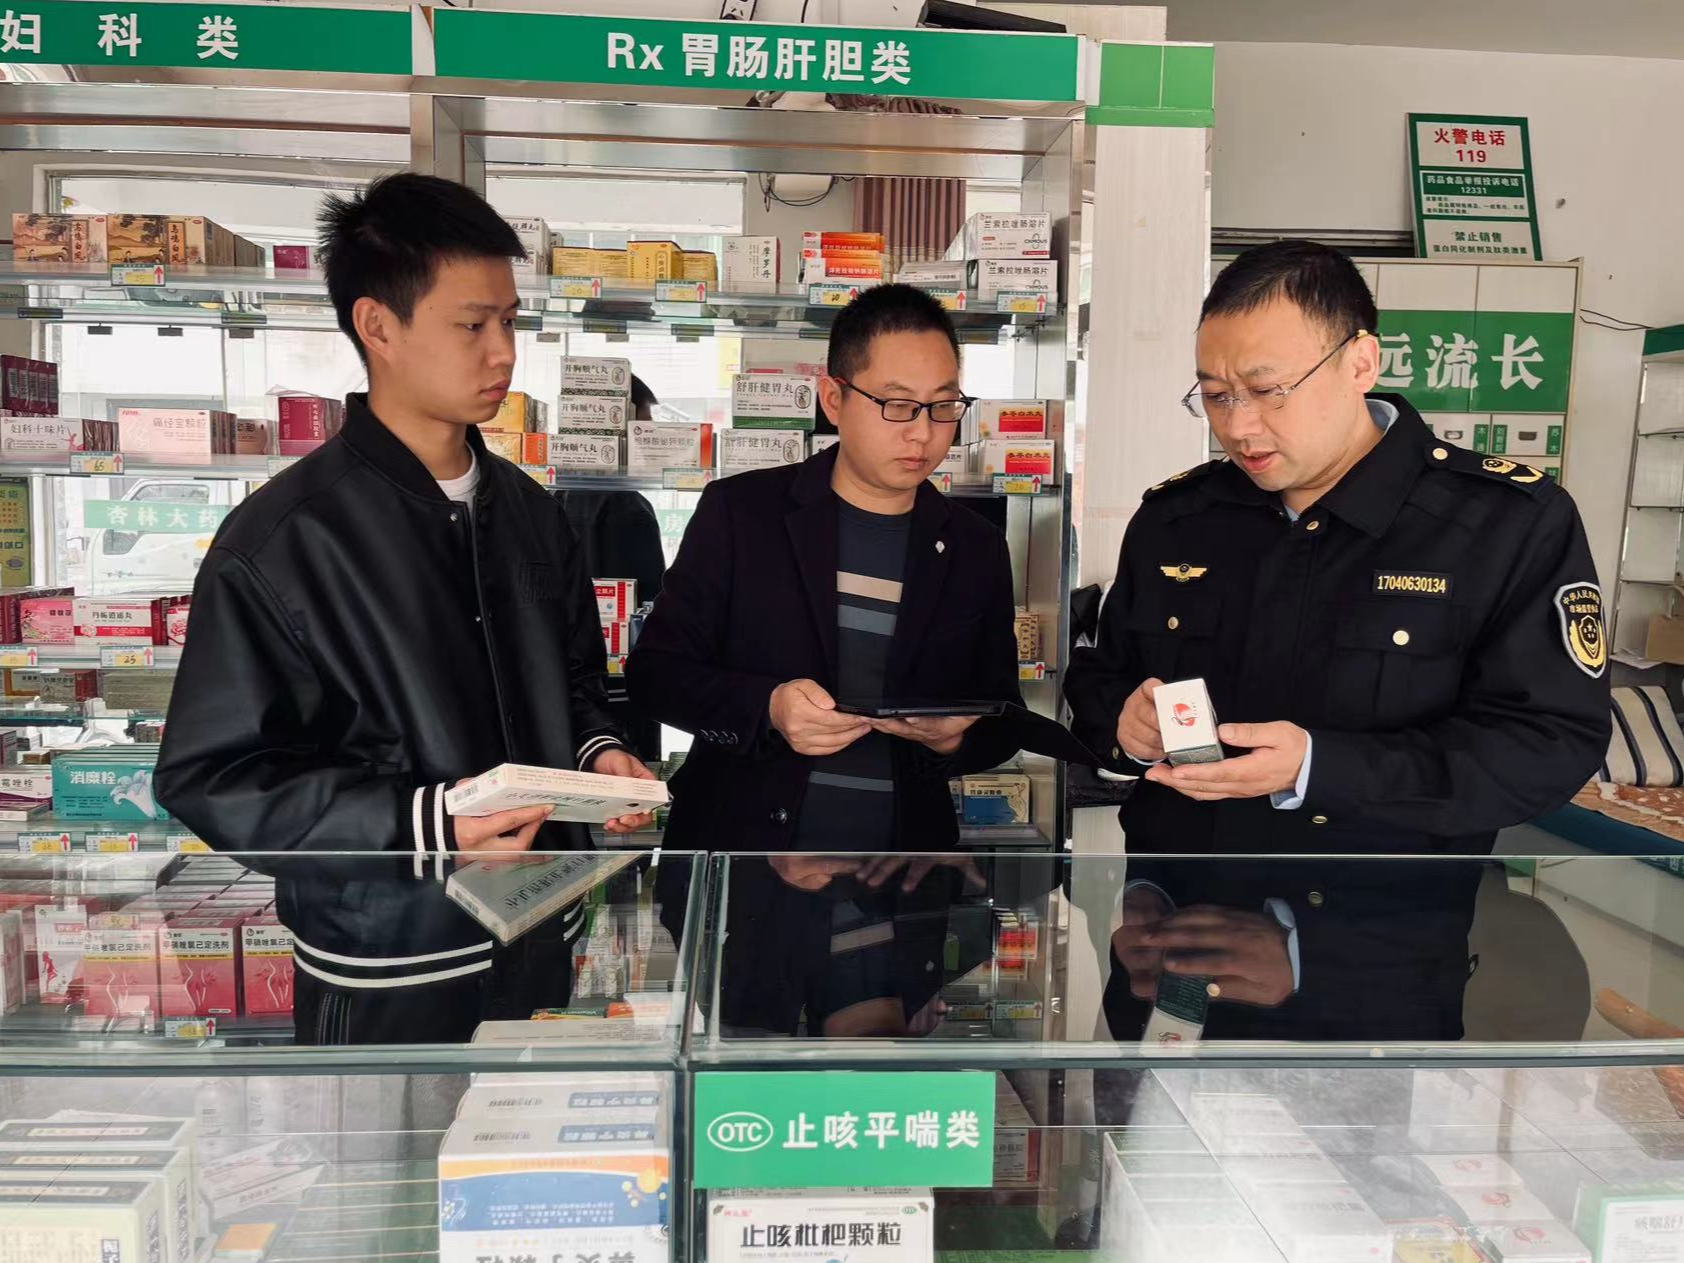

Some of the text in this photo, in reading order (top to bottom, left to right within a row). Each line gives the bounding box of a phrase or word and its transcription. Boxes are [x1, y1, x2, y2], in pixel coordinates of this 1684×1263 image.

[0, 9, 239, 59] 妇科类
[607, 32, 912, 85] Rx 胃肠肝胆类
[1434, 128, 1505, 146] 火警电话
[1456, 149, 1486, 163] 119
[1427, 175, 1519, 187] 药品食品举报投诉电话
[1461, 187, 1487, 195] 12331
[984, 219, 1047, 229] 兰索拉唑肠溶片
[1455, 231, 1502, 243] 禁止销售
[762, 246, 772, 279] 摩罗丹
[988, 266, 1049, 275] 兰索拉唑肠溶片
[1377, 332, 1545, 390] 远流长
[565, 364, 609, 375] 开胸顺气丸
[736, 382, 794, 394] 舒肝健胃丸
[561, 404, 606, 414] 开胸顺气丸
[11, 424, 66, 435] 妇科十味片
[551, 443, 598, 453] 开胸顺气丸
[725, 437, 782, 449] 舒肝健胃丸
[107, 504, 218, 529] 杏林大药
[1377, 575, 1447, 594] 17040630134
[70, 771, 116, 785] 消糜栓
[163, 940, 230, 949] 甲硝唑氯己定洗剂
[718, 1110, 981, 1151] OTC 止咳平喘类
[740, 1222, 902, 1247] 止咳枇杷颗粒
